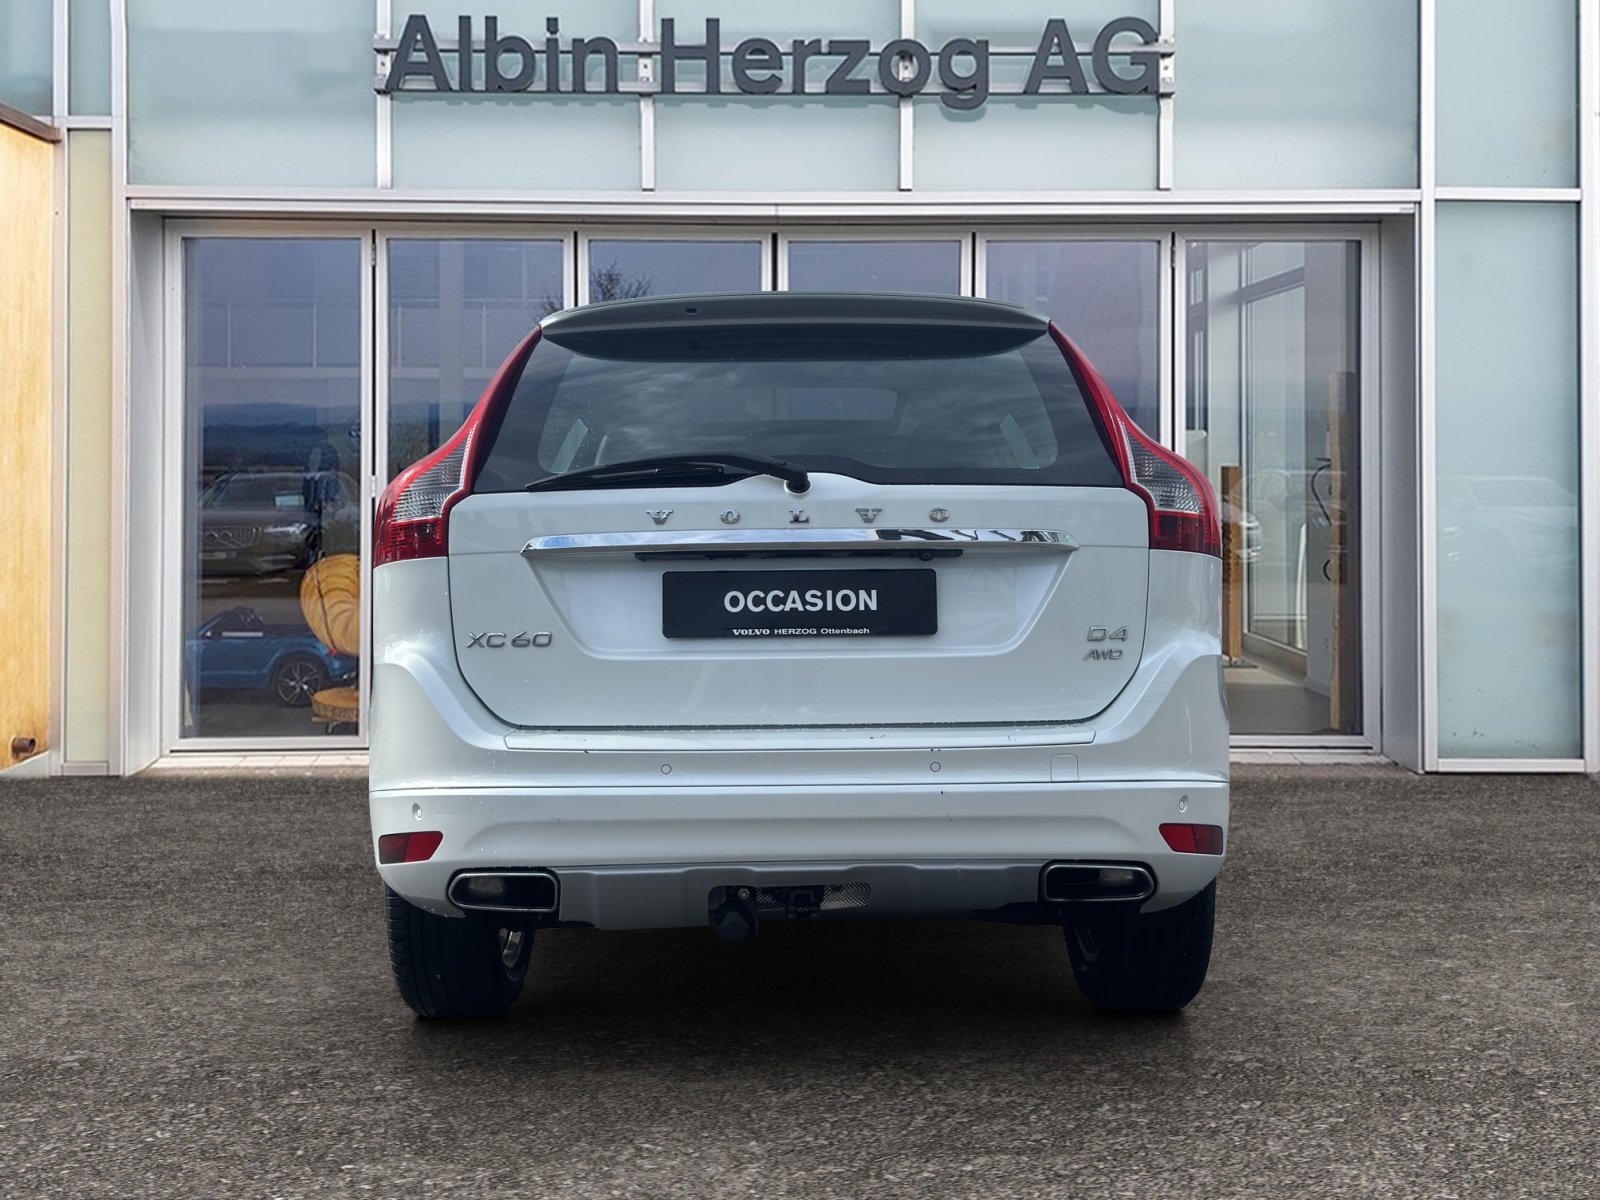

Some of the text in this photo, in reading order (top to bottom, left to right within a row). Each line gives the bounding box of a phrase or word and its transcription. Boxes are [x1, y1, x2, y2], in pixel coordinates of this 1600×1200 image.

[386, 14, 1160, 110] Albin Herzog AG
[646, 508, 950, 525] VOLVO
[723, 589, 878, 613] OCCASION
[732, 627, 870, 636] VOLVO HERZOG Ottenbach
[1086, 625, 1129, 642] D4
[1082, 649, 1124, 662] AWD
